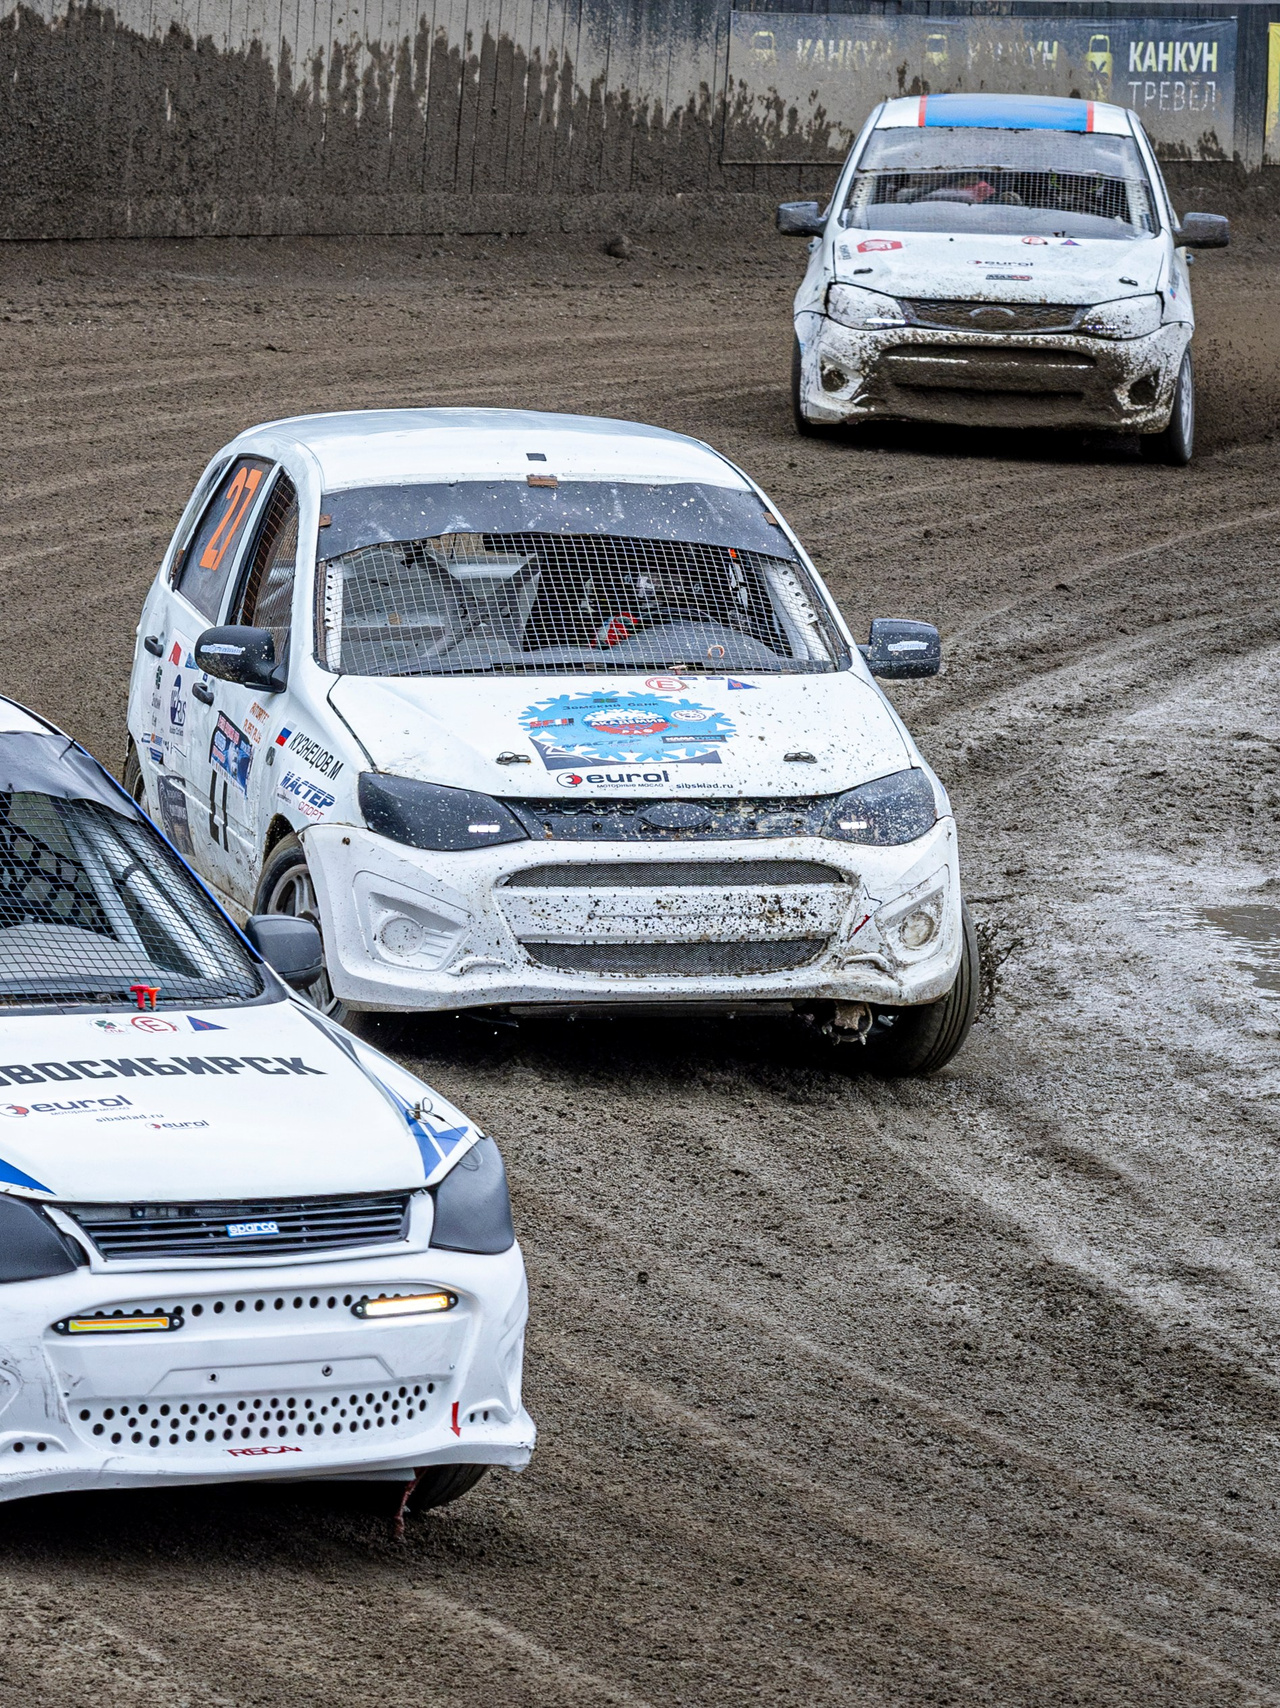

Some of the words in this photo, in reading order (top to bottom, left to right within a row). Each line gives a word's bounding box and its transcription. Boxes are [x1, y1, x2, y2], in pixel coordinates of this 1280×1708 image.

[1128, 41, 1218, 73] КАНКУН
[1127, 81, 1217, 111] ТРЕВЕЛ
[199, 467, 263, 571] 27
[591, 718, 666, 727] АКАДЕМИЯ
[288, 732, 345, 780] КУЗНЕЦОВ.М
[586, 770, 670, 784] eurol
[280, 771, 336, 808] МАСТЕР
[30, 1094, 134, 1113] eurol
[95, 1112, 165, 1123] sibsklad.ru
[161, 1119, 211, 1129] eurol
[227, 1221, 278, 1234] sparco
